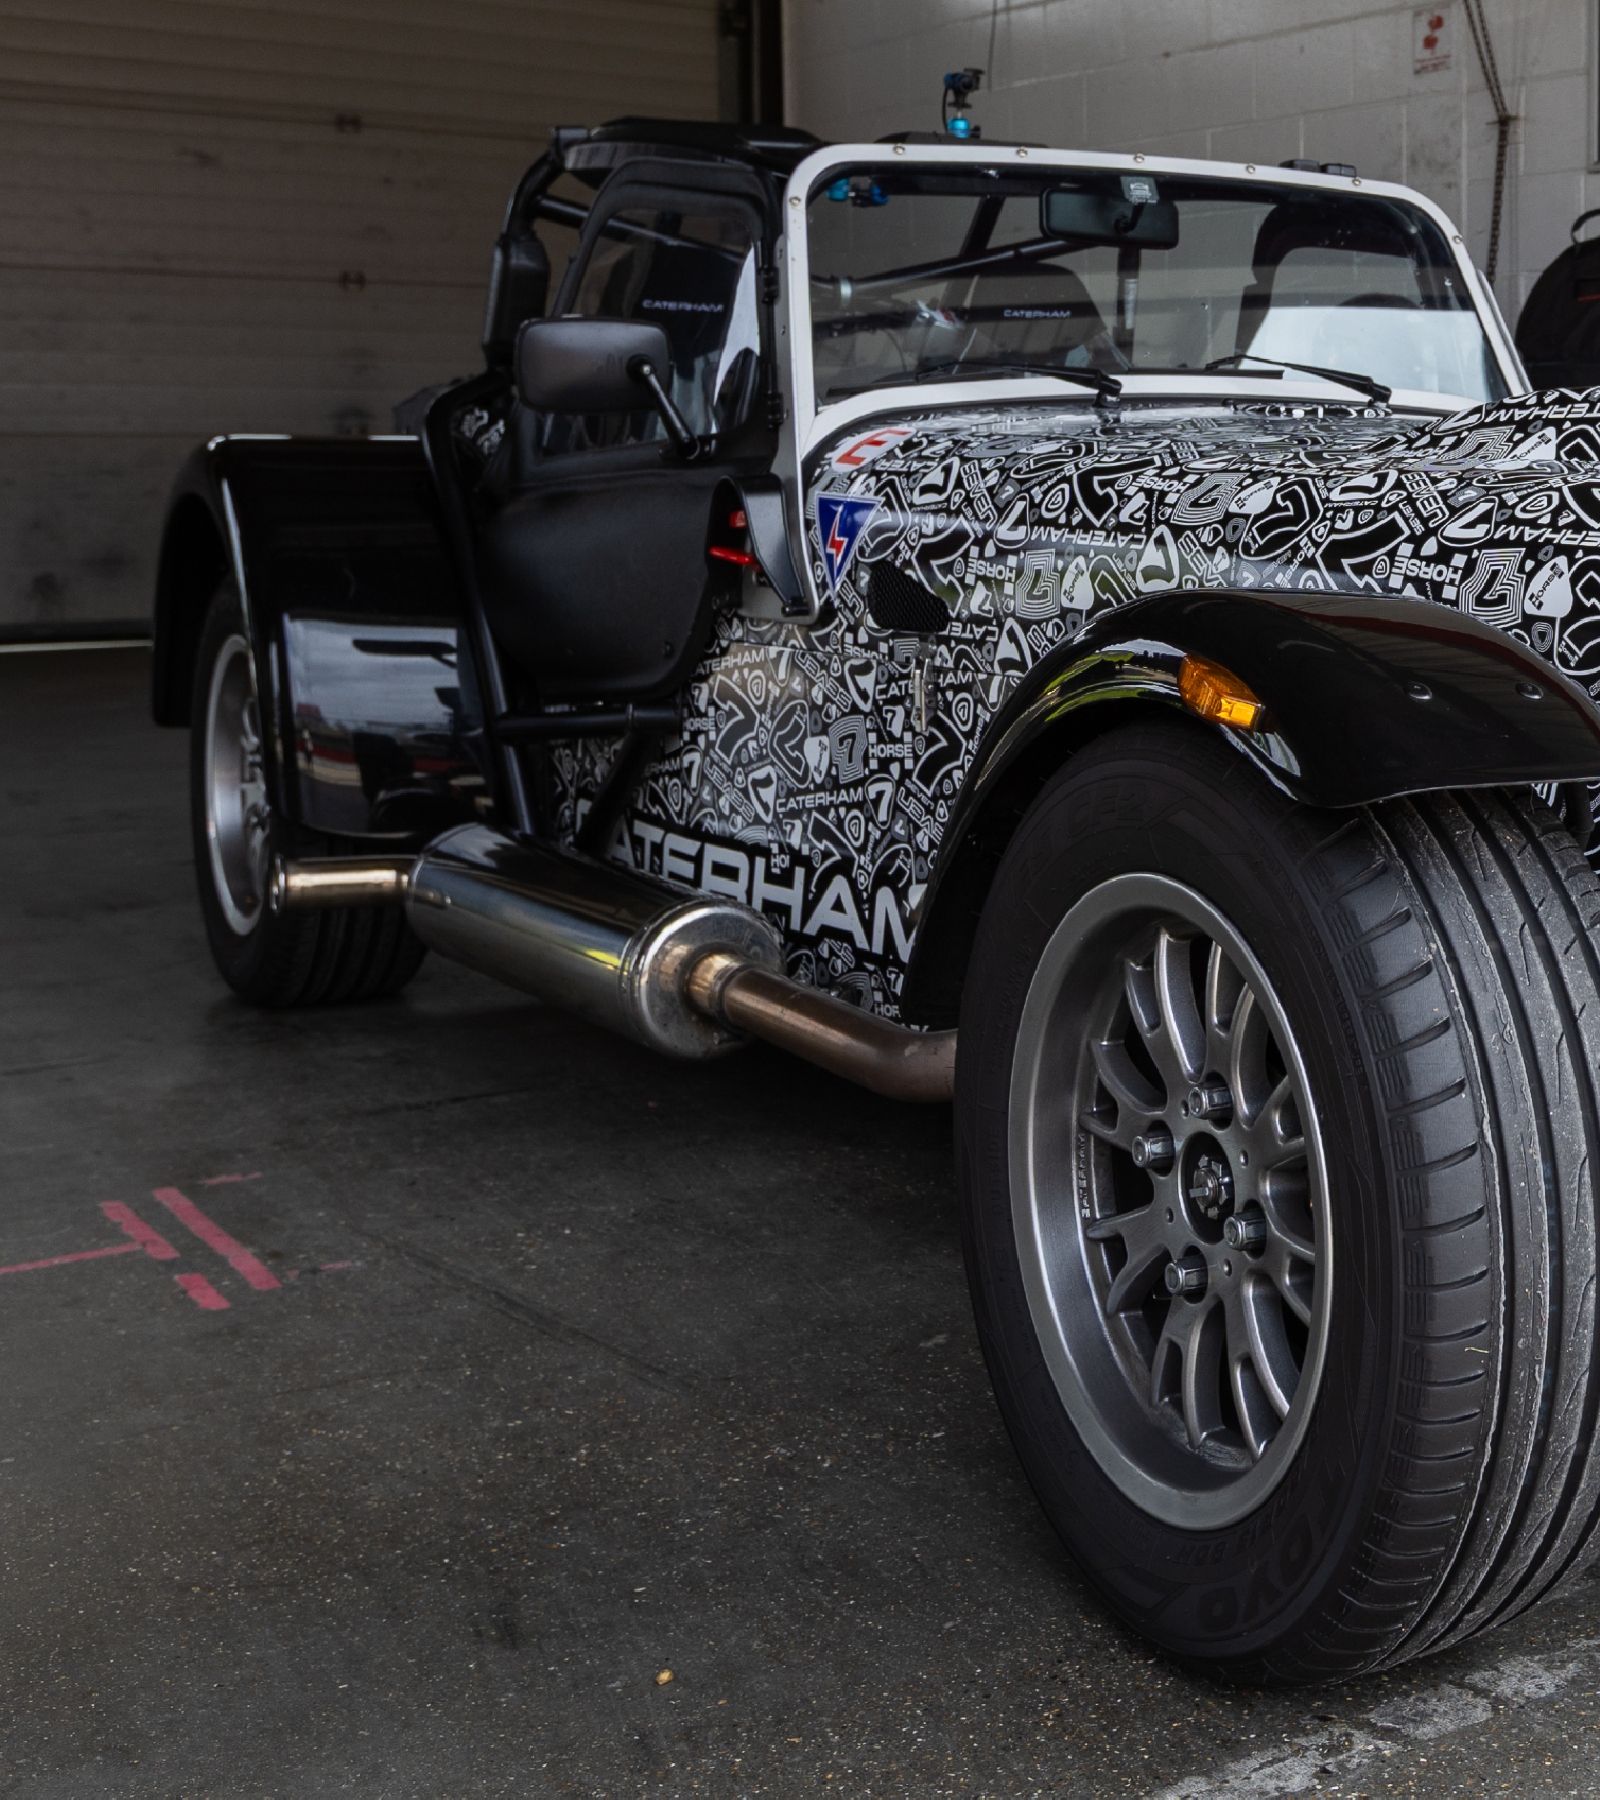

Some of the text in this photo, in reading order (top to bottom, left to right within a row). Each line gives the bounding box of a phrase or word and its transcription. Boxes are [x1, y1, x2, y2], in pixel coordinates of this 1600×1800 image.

[642, 299, 724, 312] CATERHAM
[1003, 309, 1071, 318] CATERHAM
[875, 458, 939, 472] CATER
[1031, 525, 1147, 550] CATERHAM
[968, 558, 1016, 582] HORSE
[1179, 530, 1228, 591] SEV
[1393, 556, 1464, 584] HORSE
[692, 649, 765, 676] ATERHAM
[876, 672, 973, 700] CATEHAM
[869, 743, 913, 758] HORSE
[776, 788, 864, 812] CATERHAM
[577, 799, 917, 964] ATERHAM
